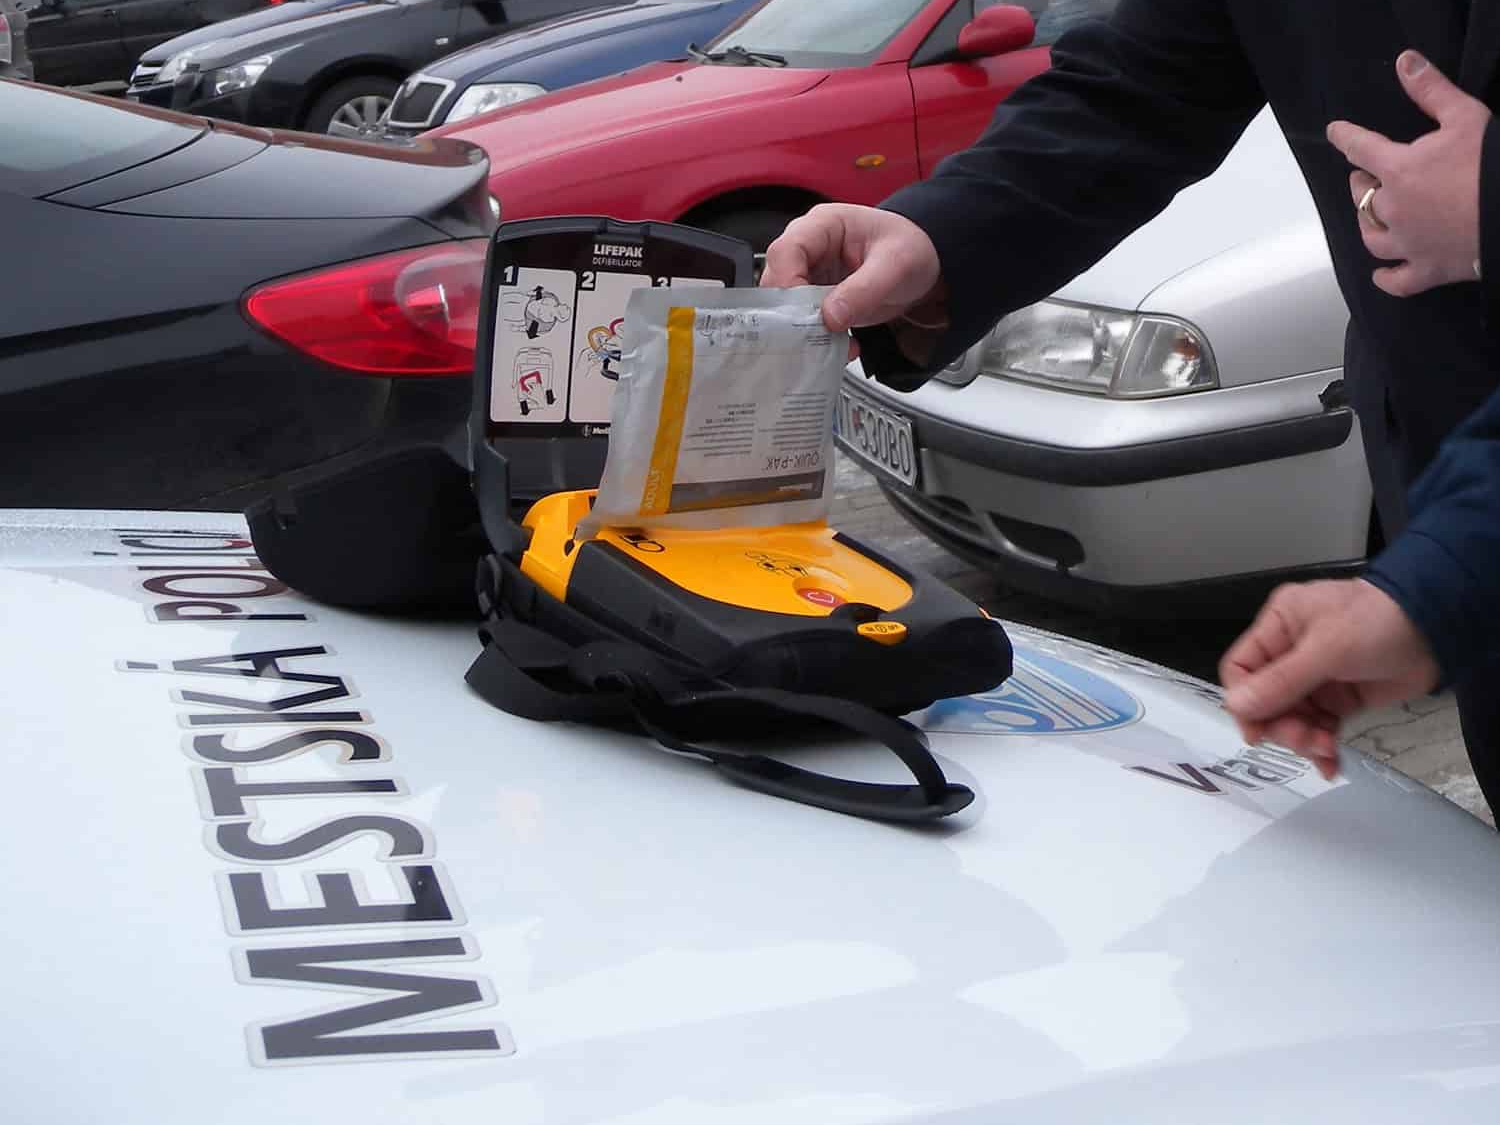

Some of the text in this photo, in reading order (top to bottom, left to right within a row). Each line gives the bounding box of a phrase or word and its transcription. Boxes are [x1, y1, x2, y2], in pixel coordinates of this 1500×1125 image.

[593, 244, 643, 258] LIFEPAK
[592, 257, 642, 268] DEFIBRILLATOR
[504, 266, 514, 283] 1
[581, 271, 595, 288] 2
[126, 645, 502, 1061] MESTSKÁ
